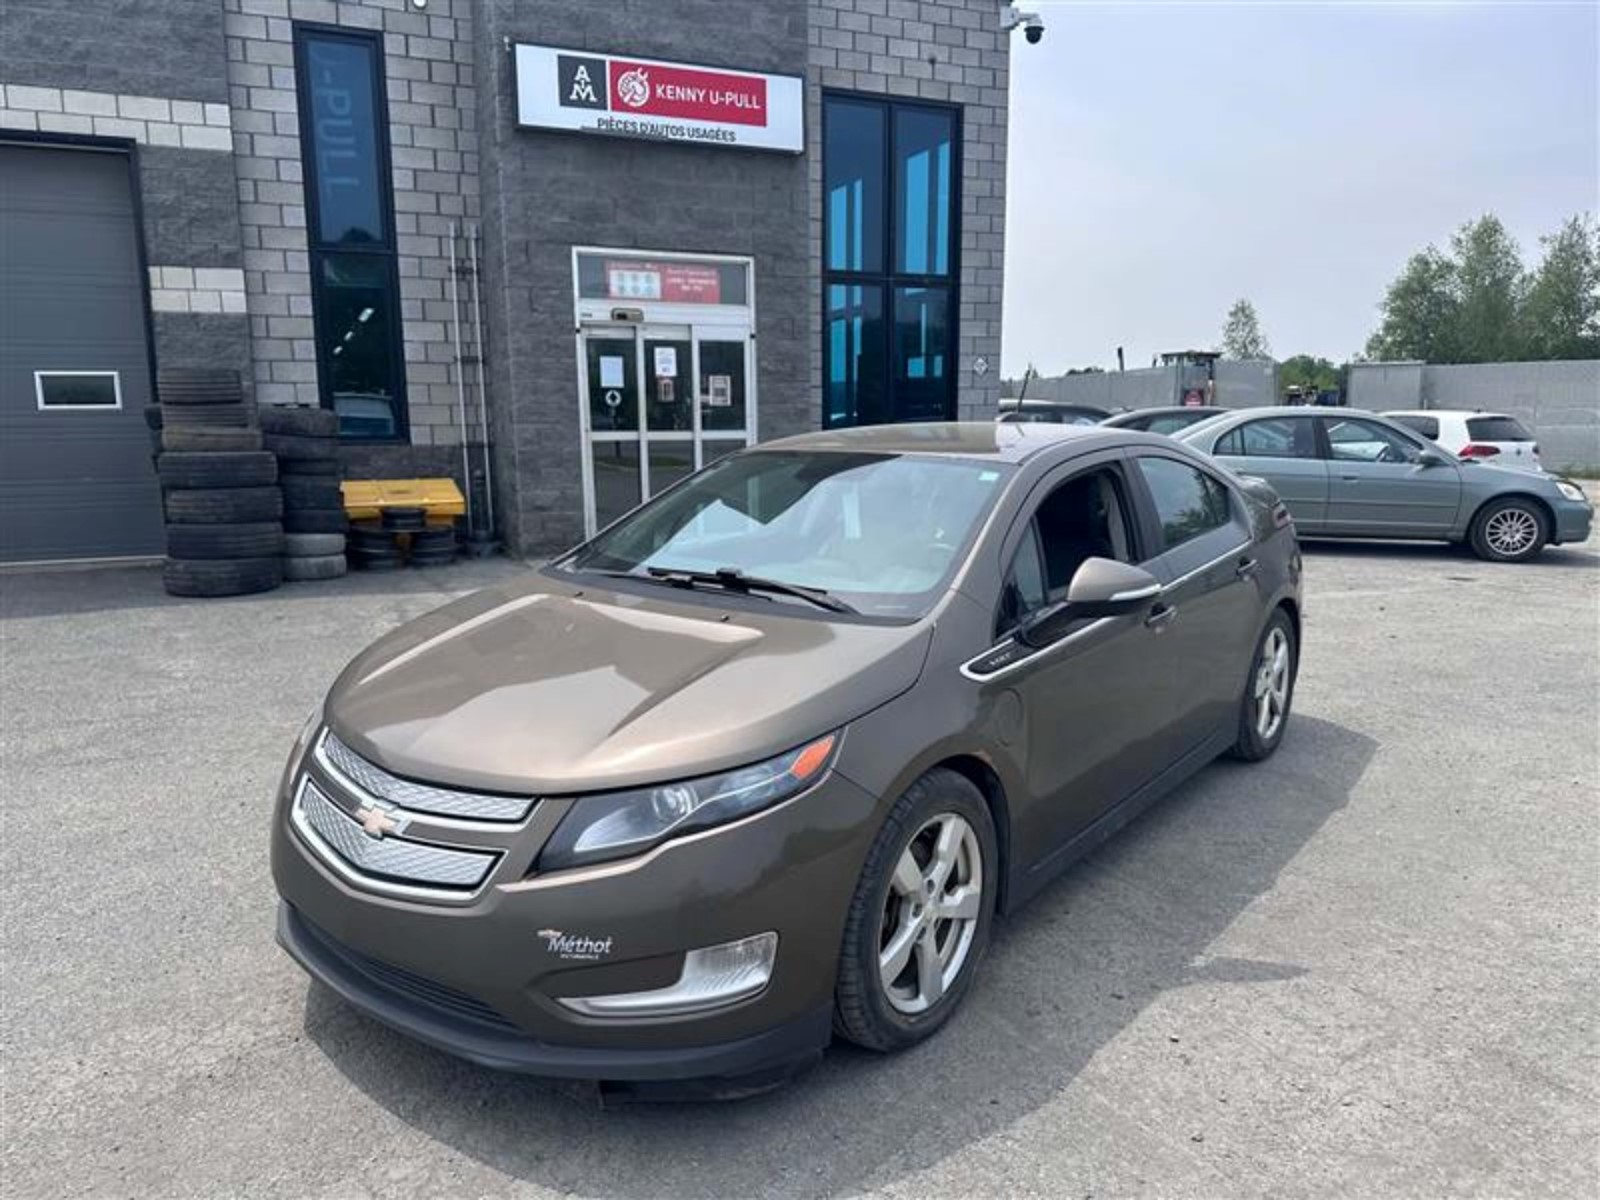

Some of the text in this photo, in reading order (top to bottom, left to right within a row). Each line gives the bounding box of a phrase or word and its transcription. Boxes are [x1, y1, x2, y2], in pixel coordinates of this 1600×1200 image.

[655, 83, 761, 109] KENNY U-PULL
[597, 116, 737, 142] PIÈCES D'AUTOS USAGÉES
[547, 935, 613, 954] Méthot
